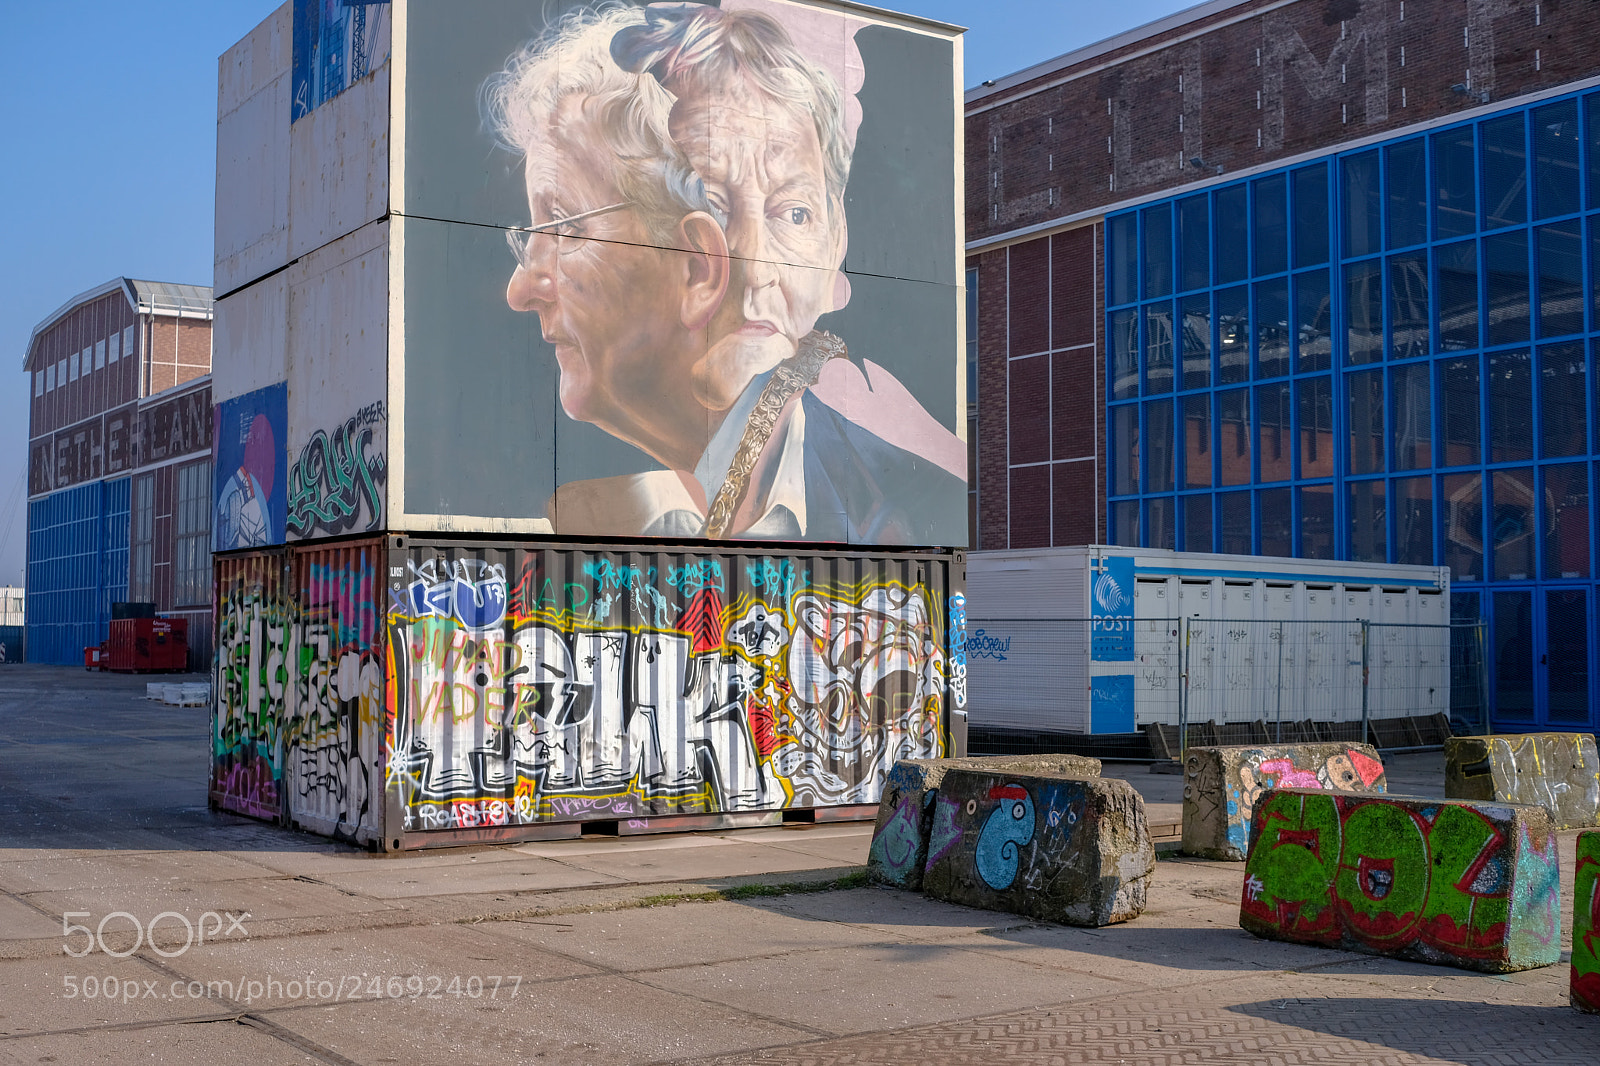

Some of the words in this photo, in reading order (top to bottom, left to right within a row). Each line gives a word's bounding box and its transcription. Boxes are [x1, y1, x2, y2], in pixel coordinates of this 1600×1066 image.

[1093, 615, 1132, 631] POST
[411, 621, 522, 681] JIHAD
[412, 678, 541, 733] VADER
